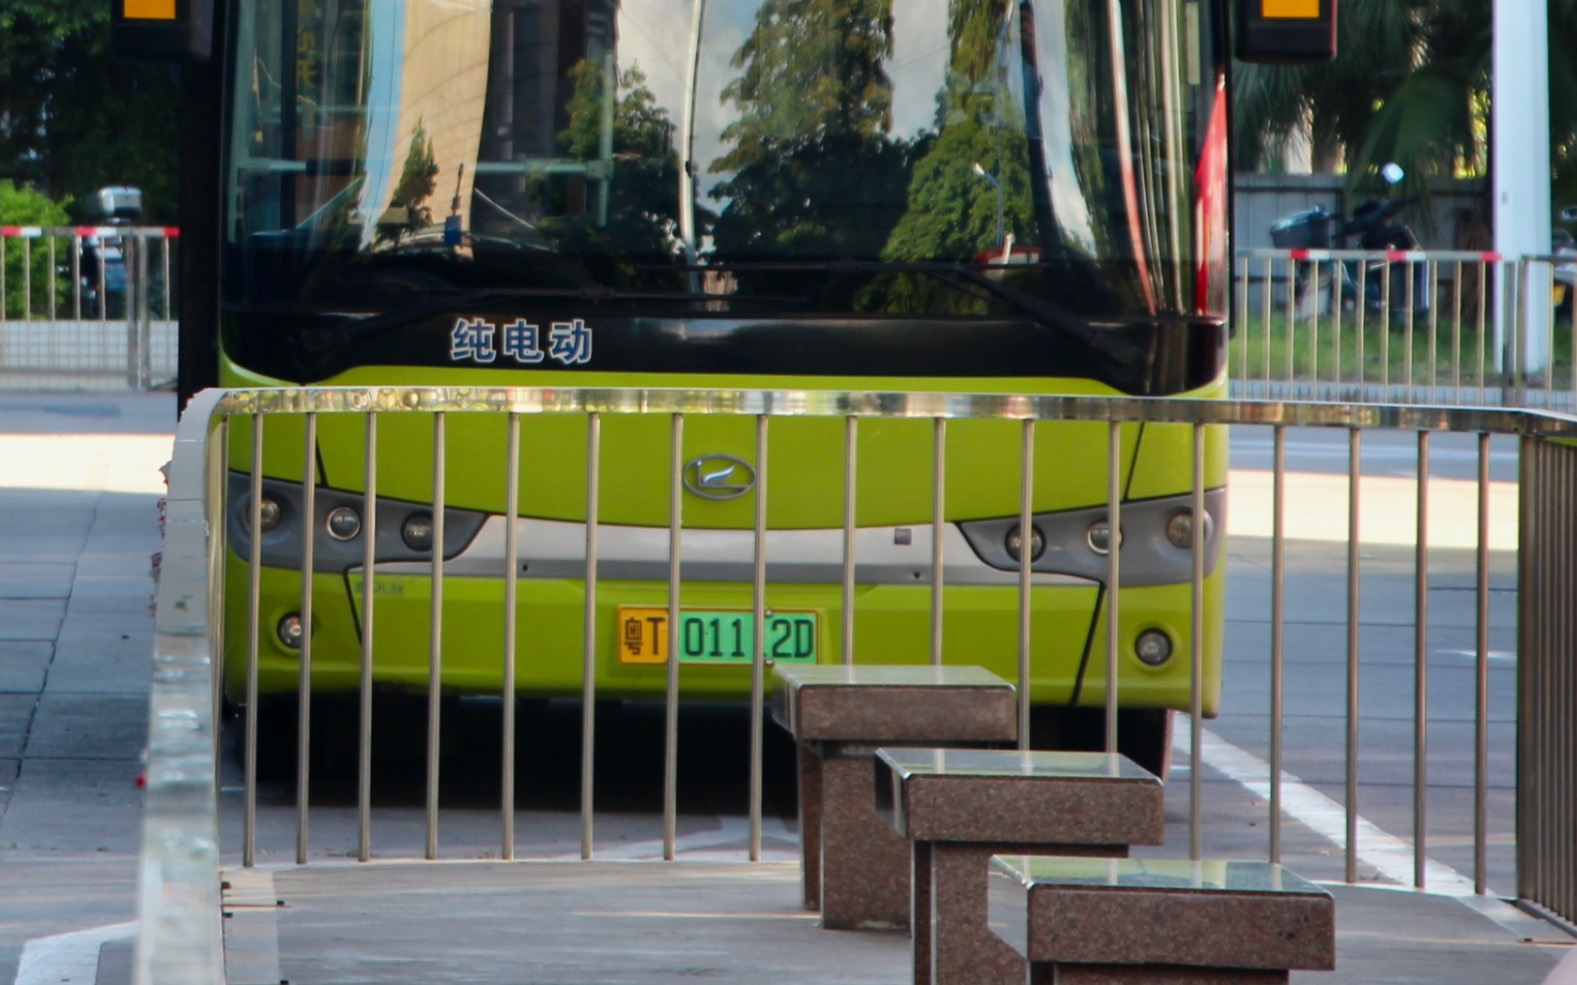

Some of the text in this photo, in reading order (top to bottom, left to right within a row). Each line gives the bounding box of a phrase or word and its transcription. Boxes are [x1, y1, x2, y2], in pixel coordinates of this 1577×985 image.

[450, 317, 593, 365] 纯电动
[685, 617, 814, 658] 0112D
